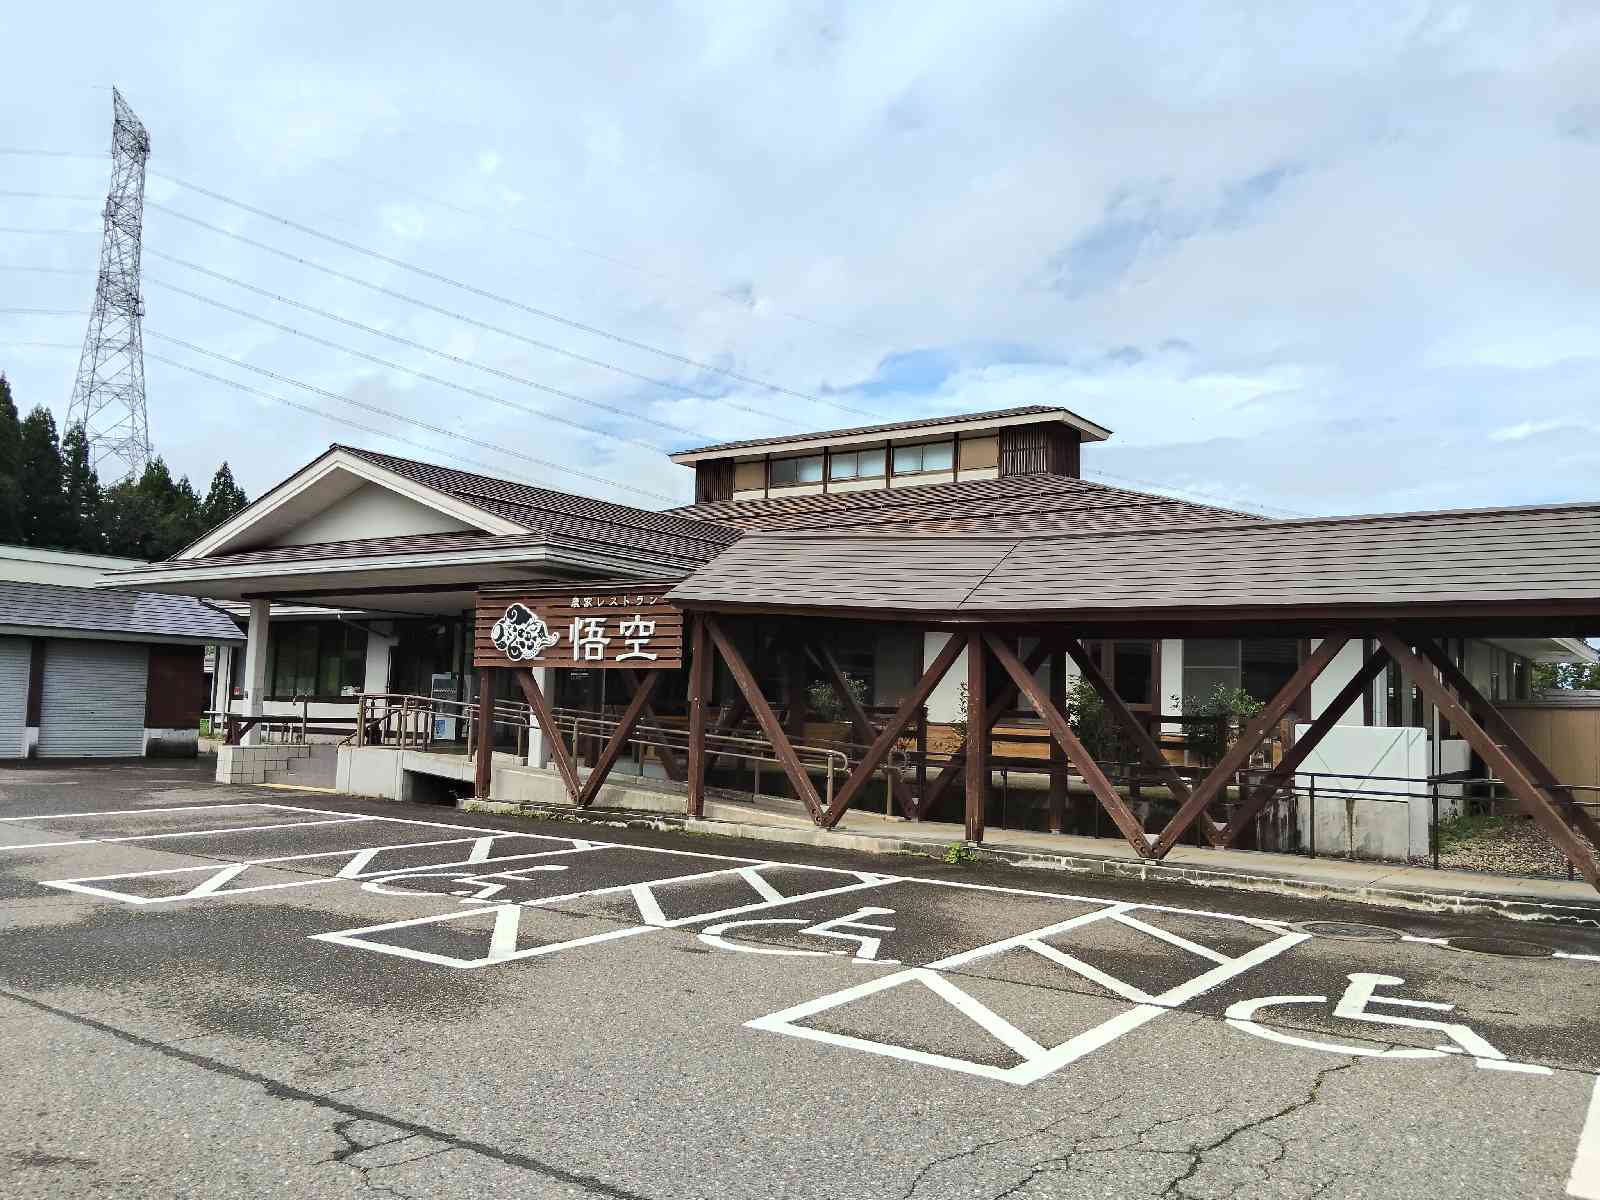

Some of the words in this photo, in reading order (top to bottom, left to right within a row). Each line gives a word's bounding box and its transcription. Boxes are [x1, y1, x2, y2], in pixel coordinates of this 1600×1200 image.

[571, 595, 658, 608] 農家レストラン
[569, 614, 658, 662] 悟空
